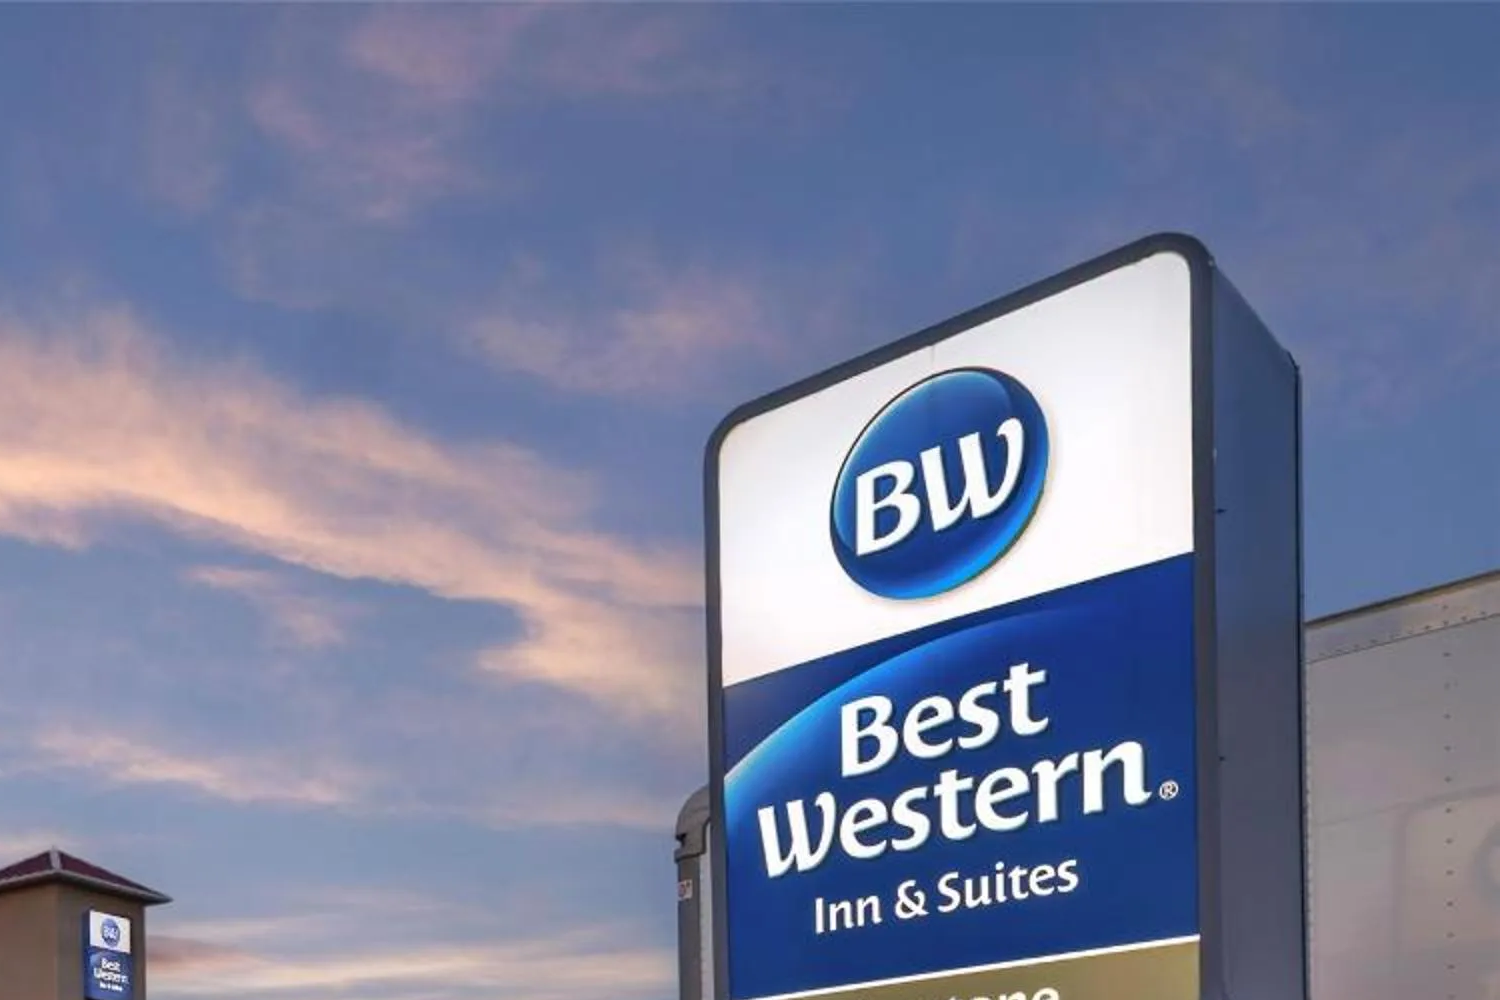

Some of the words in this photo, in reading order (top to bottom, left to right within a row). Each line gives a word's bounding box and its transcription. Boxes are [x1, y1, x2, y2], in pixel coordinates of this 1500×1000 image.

[855, 417, 1025, 558] BW
[840, 661, 1050, 779] Best
[813, 893, 883, 935] Inn
[894, 878, 929, 920] &
[937, 858, 1080, 914] Suites
